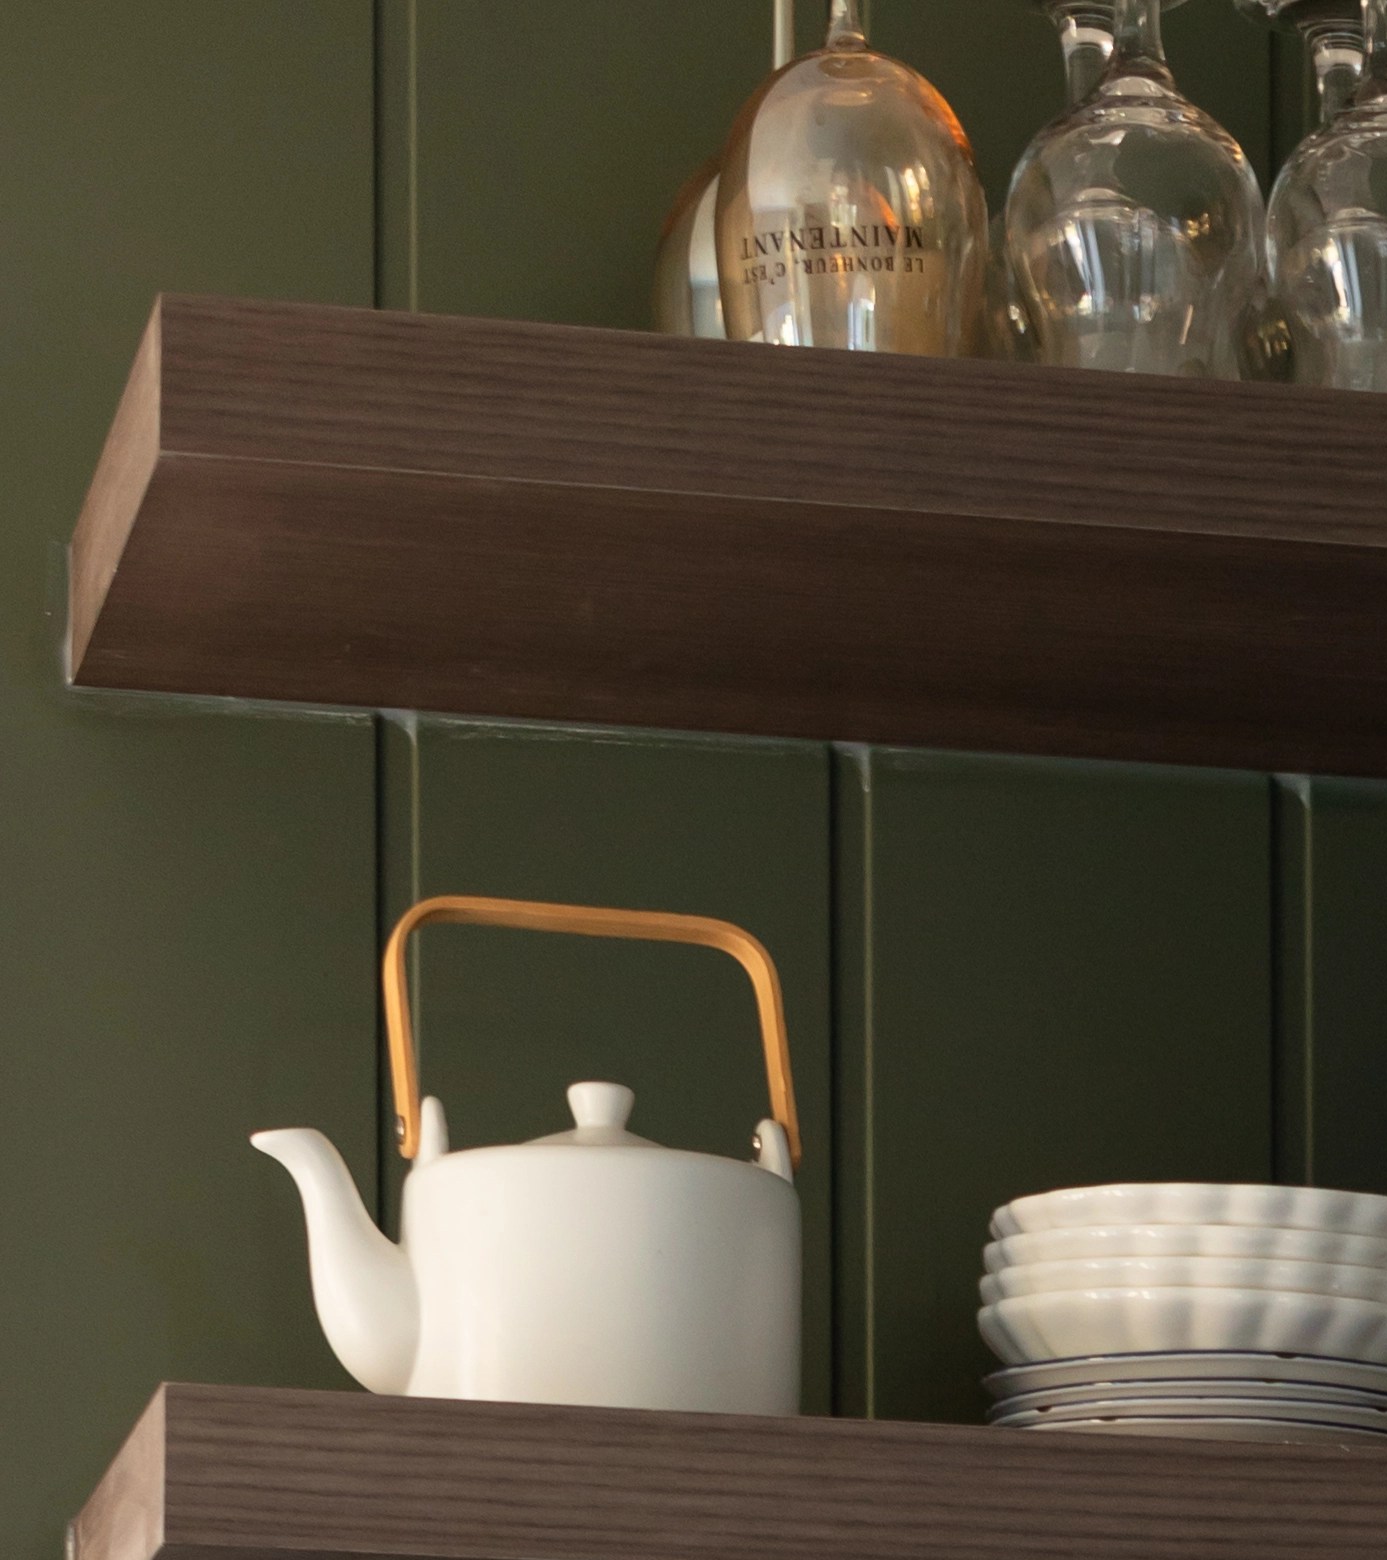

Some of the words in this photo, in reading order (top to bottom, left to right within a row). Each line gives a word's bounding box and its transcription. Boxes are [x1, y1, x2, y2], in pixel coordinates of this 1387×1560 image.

[740, 225, 924, 261] MAINTENANT
[743, 262, 786, 285] C'EST
[904, 258, 924, 273] LE
